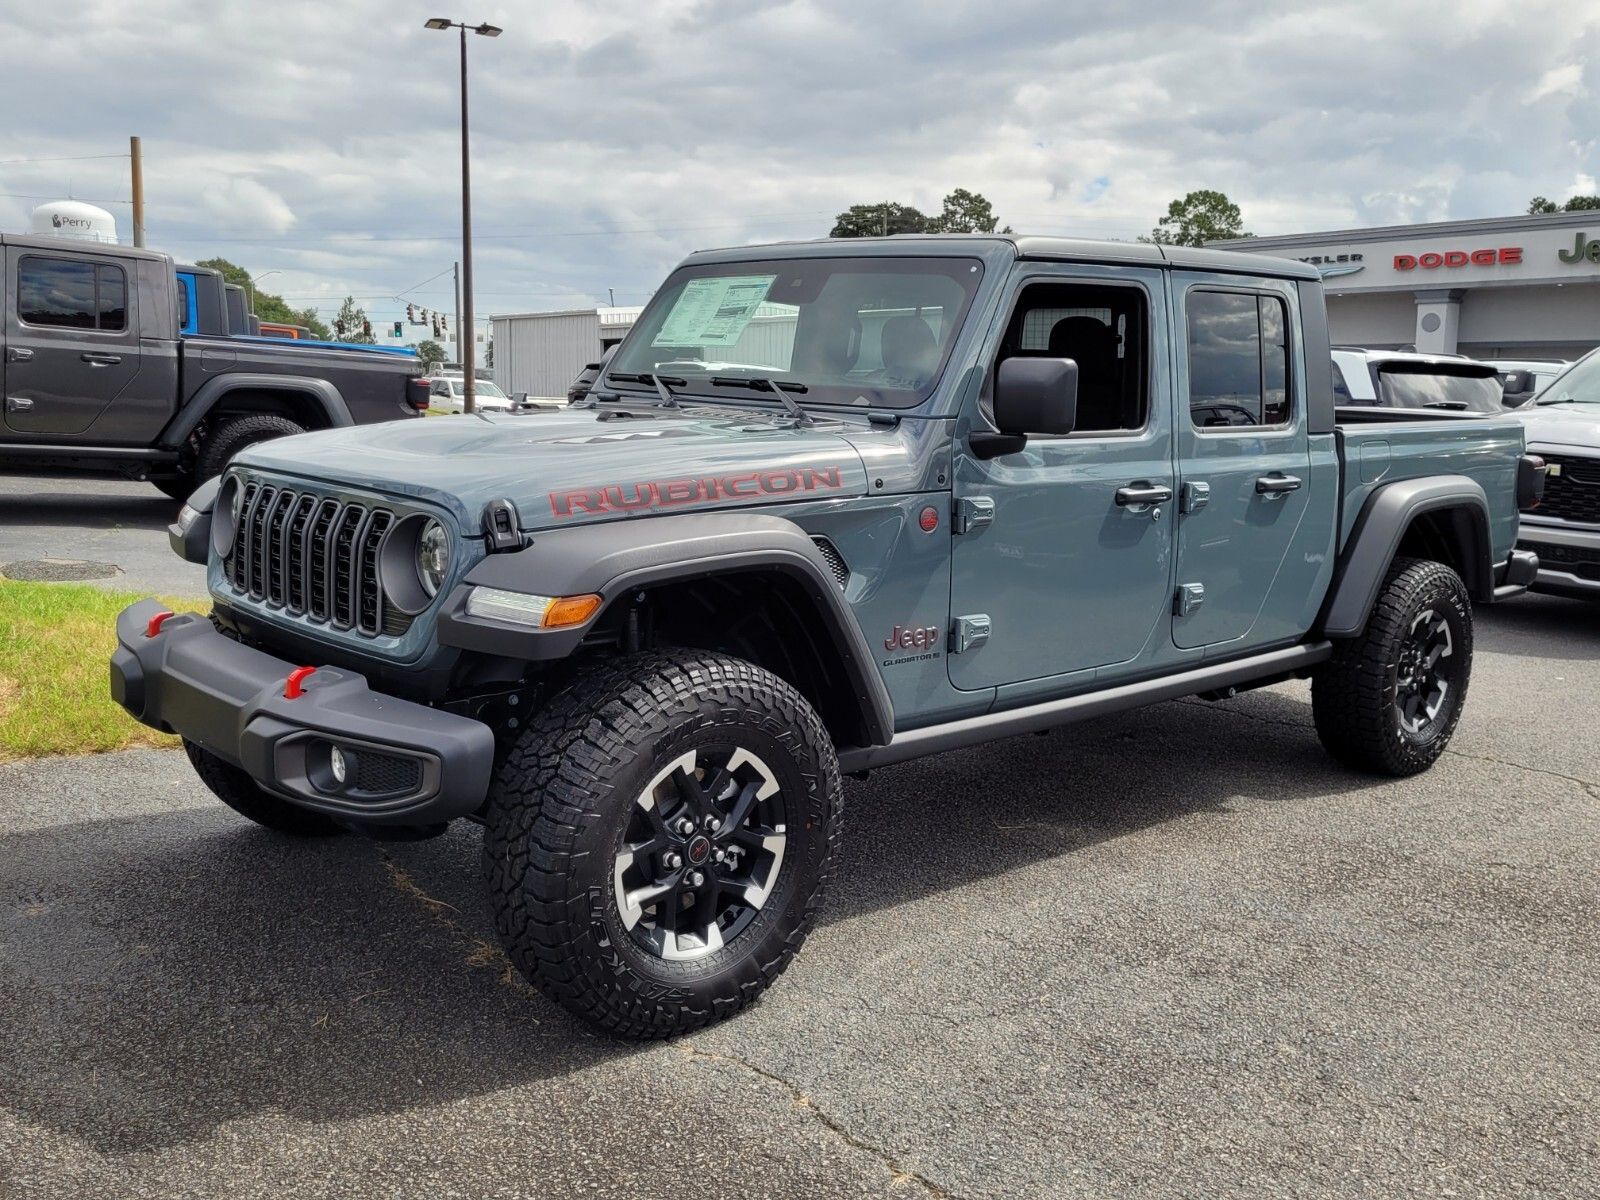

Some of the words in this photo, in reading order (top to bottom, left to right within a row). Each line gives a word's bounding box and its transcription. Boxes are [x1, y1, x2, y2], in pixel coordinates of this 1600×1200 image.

[62, 216, 91, 230] Perry
[1291, 254, 1363, 264] YSLER
[1394, 247, 1523, 271] DODGE
[1558, 232, 1600, 264] Je
[549, 466, 843, 518] RUBICON
[884, 626, 939, 651] Jeep
[883, 654, 932, 667] GLADIATOR
